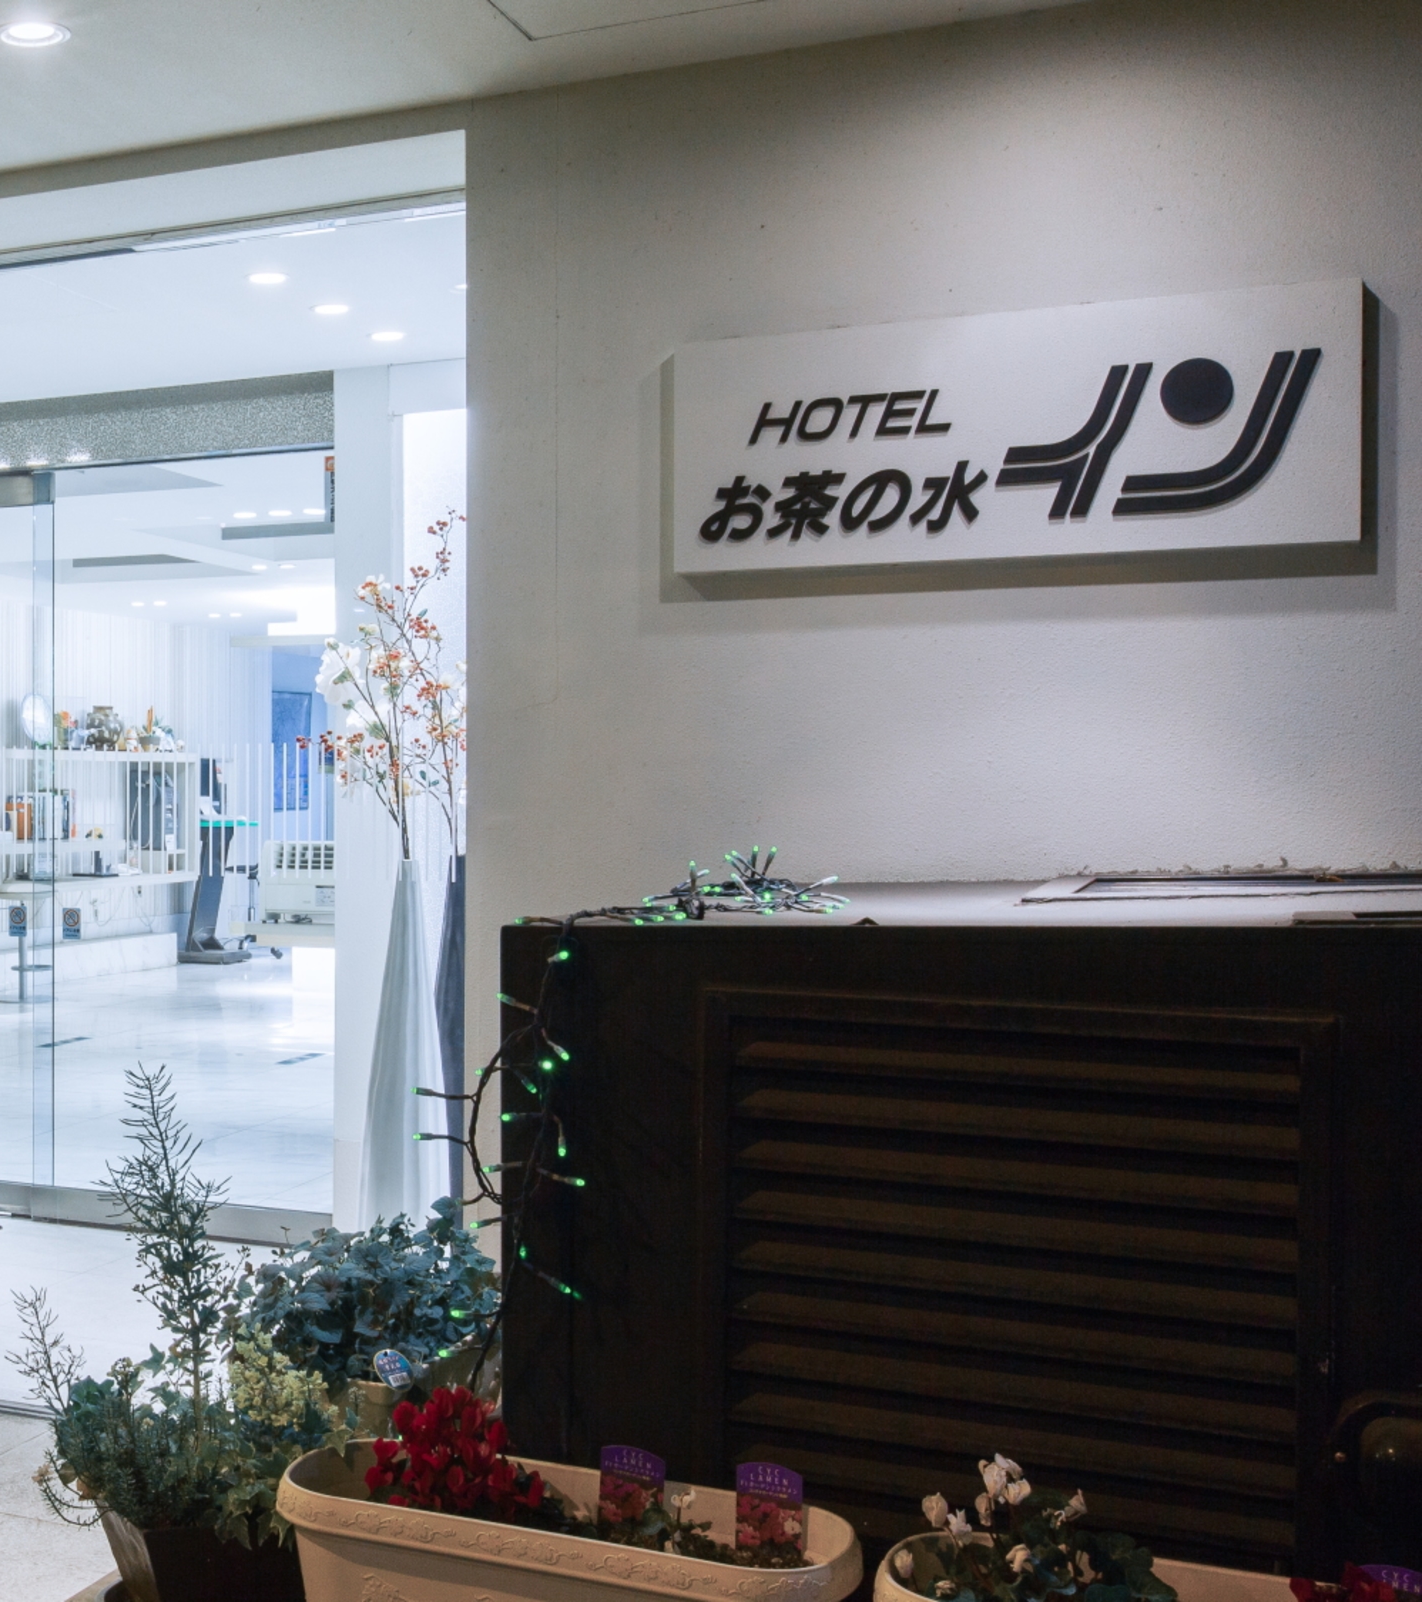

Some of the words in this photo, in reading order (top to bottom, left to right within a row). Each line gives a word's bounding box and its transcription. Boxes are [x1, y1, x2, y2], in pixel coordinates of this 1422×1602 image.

[747, 388, 952, 446] HOTEL
[698, 460, 989, 543] お茶の水
[623, 1449, 644, 1460] CYC
[615, 1455, 653, 1469] LAMEN
[758, 1466, 780, 1476] CYC
[750, 1473, 789, 1486] LAMEN
[1381, 1569, 1410, 1583] CYC
